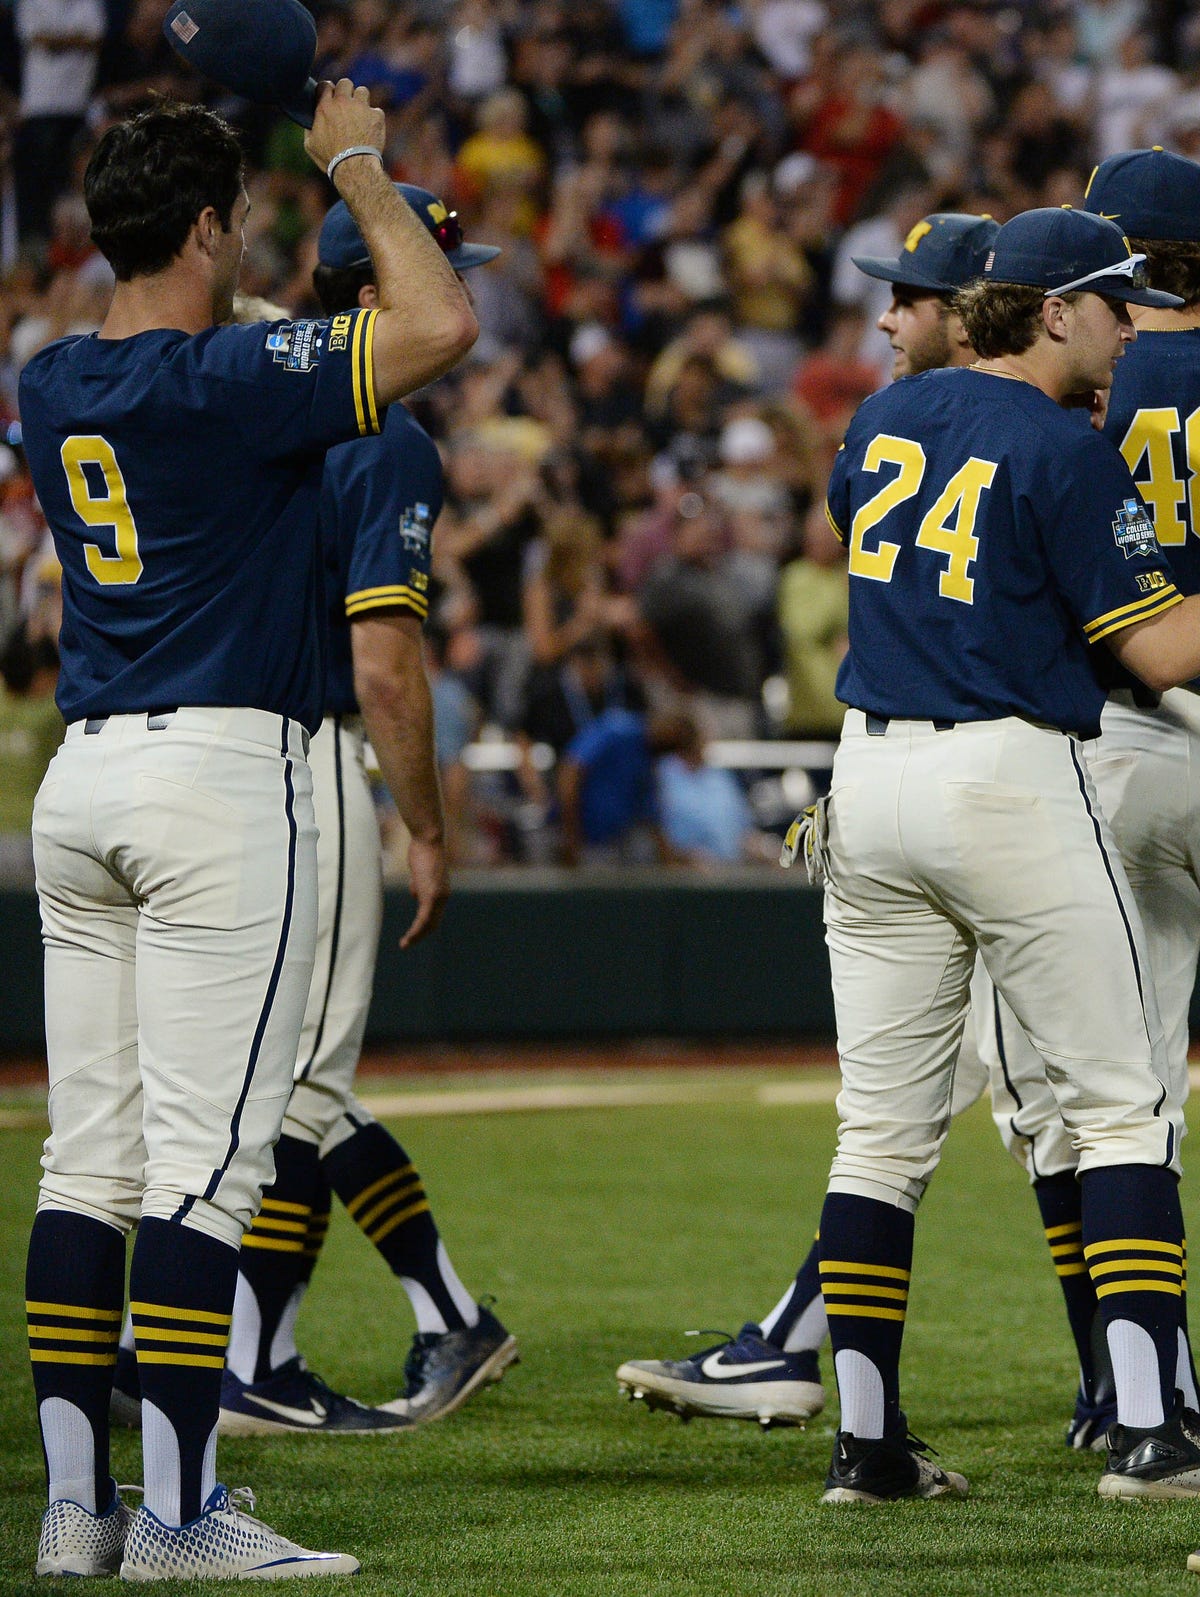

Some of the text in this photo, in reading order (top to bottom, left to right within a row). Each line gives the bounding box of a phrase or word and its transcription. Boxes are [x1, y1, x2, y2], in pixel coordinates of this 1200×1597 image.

[293, 328, 305, 358] COLLEGE
[301, 322, 316, 370] WORLD SERIES
[60, 434, 144, 585] 9
[848, 433, 999, 605] 24
[1125, 523, 1148, 535] COLLEGE
[1117, 532, 1140, 545] WORLD
